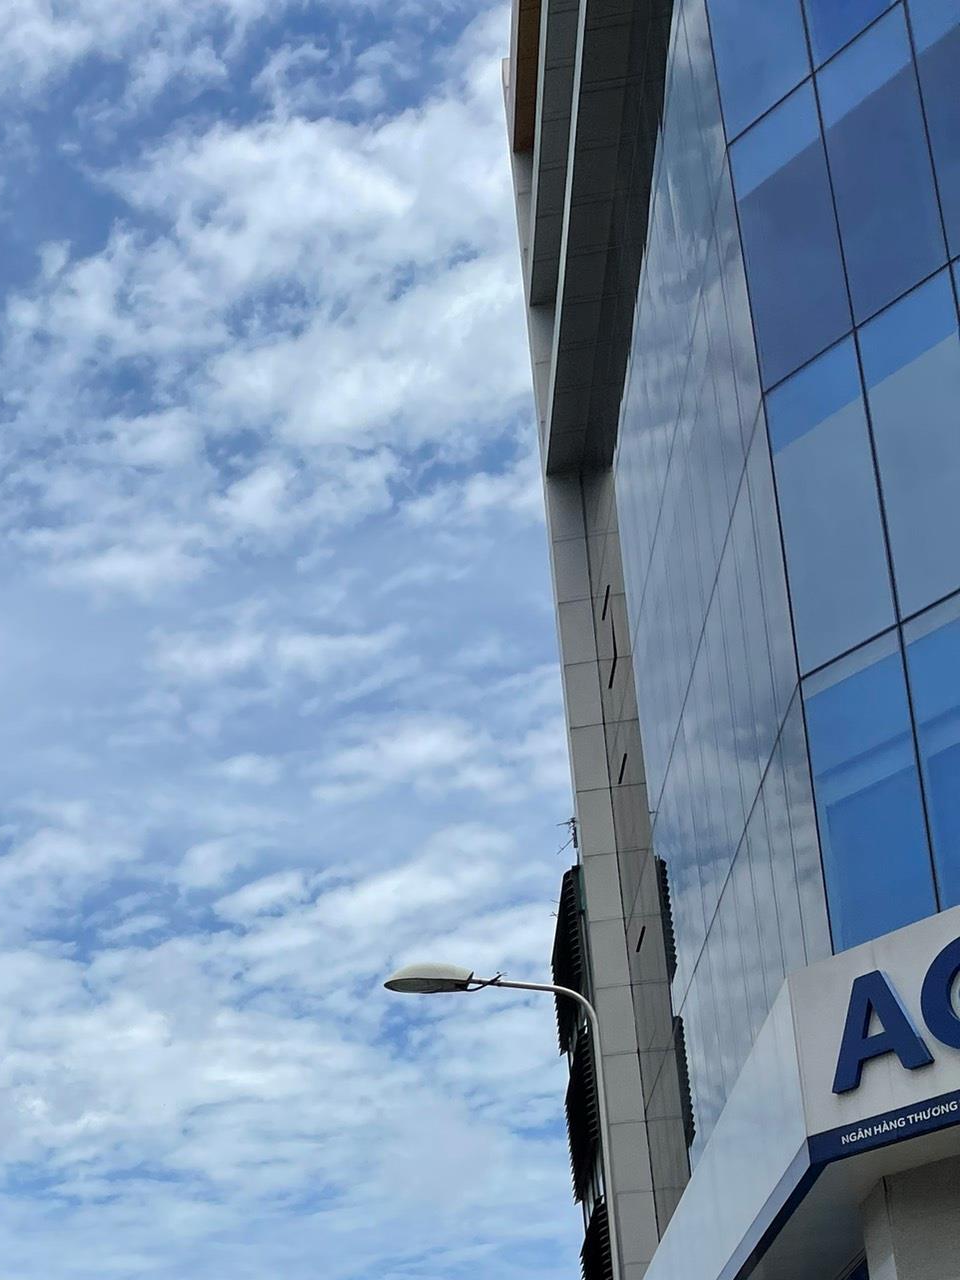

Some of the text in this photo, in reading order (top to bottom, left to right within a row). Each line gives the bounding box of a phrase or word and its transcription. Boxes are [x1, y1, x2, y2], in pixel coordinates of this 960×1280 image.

[842, 1101, 958, 1145] NGÂN HÀNG THƯƠNG
